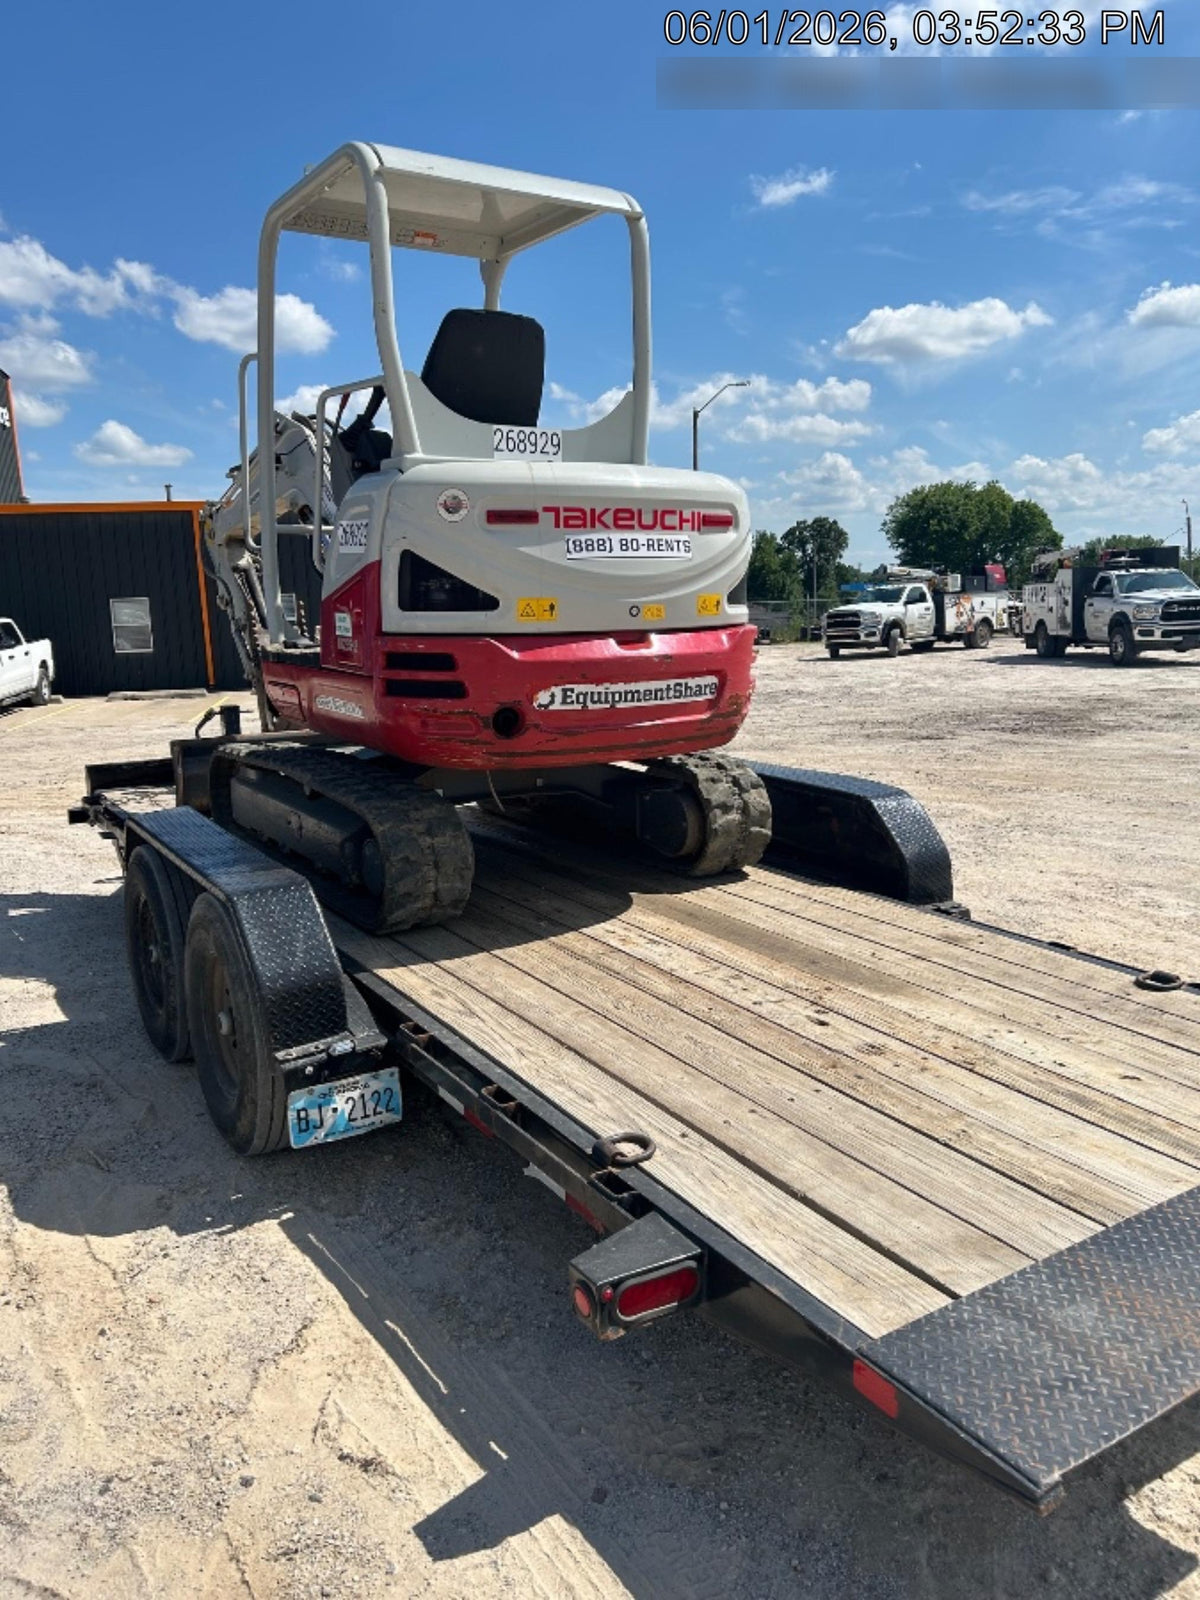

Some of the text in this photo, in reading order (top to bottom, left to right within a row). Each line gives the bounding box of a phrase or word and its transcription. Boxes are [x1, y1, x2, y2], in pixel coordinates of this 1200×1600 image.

[493, 428, 561, 456] 268929
[566, 537, 613, 553] (888)
[561, 682, 717, 709] EquipmentShare
